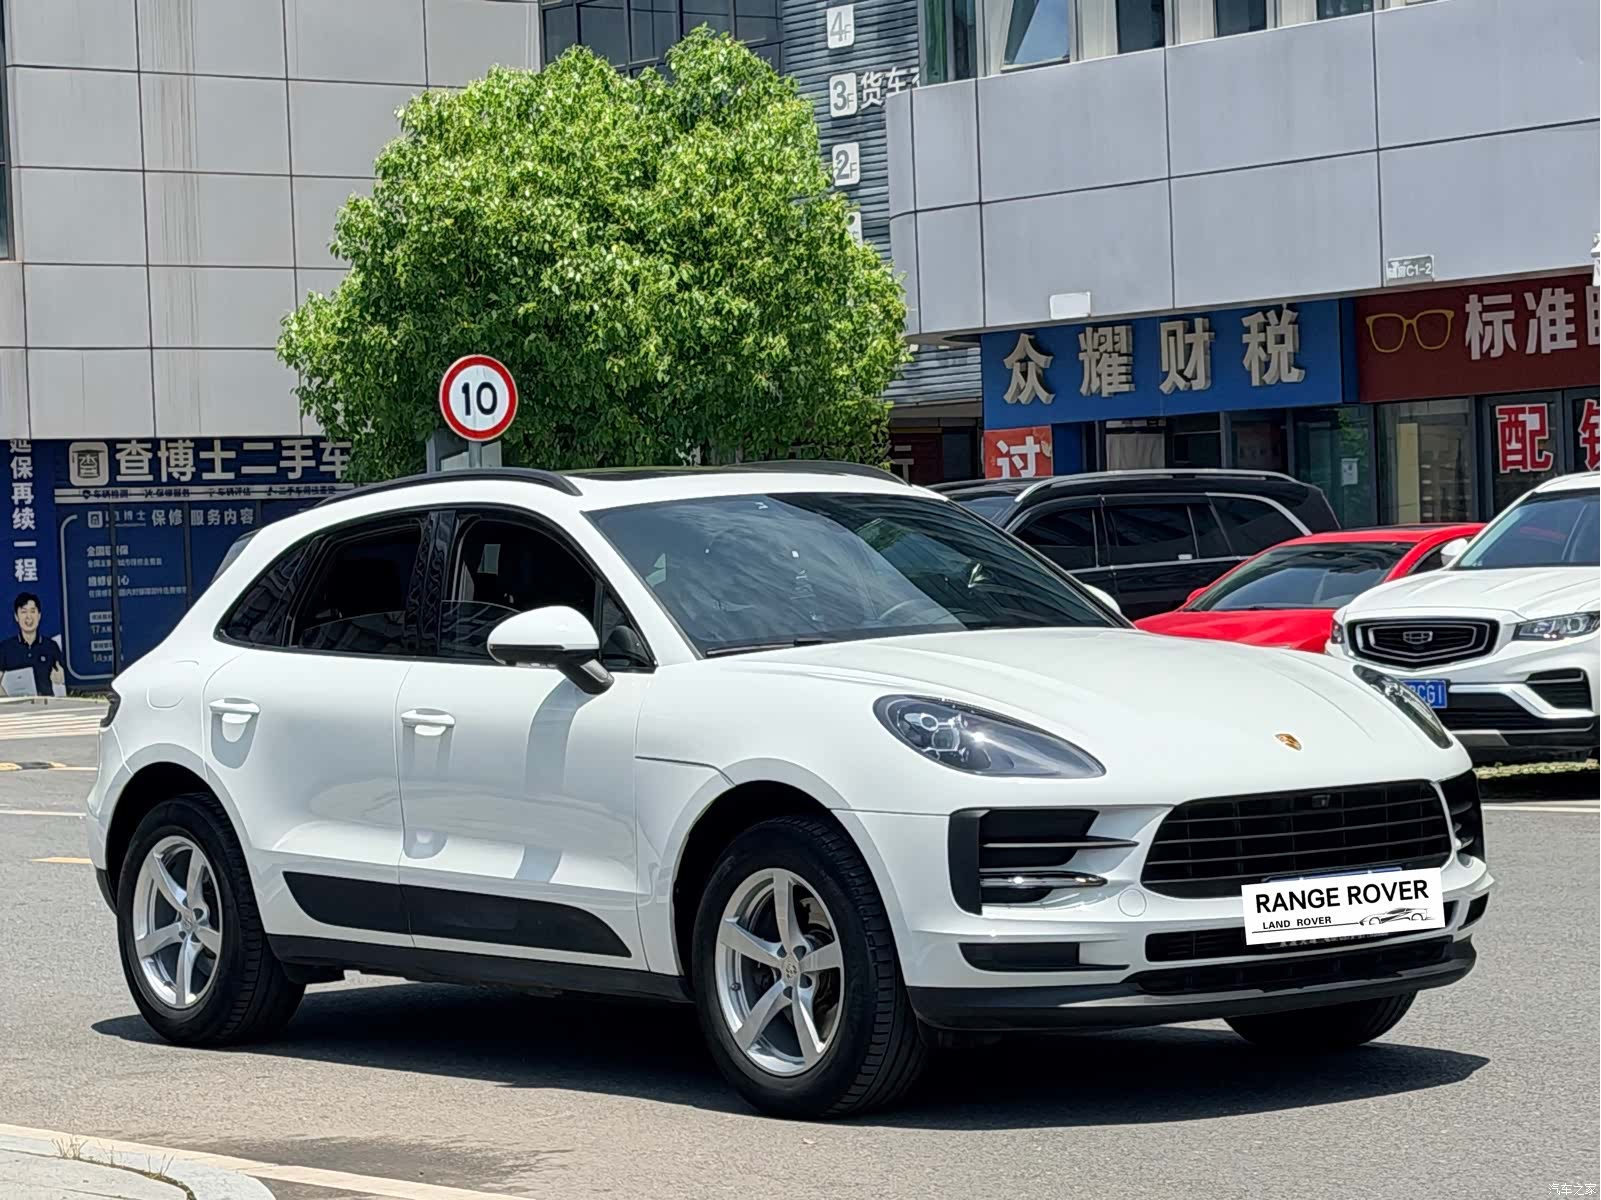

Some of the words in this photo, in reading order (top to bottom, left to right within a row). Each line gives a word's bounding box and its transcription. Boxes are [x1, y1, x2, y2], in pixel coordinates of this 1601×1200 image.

[829, 11, 852, 42] 4F
[832, 79, 855, 112] 3F
[860, 66, 920, 109] 货车
[835, 149, 858, 181] 2F
[1002, 302, 1306, 405] 众耀财税
[461, 381, 498, 416] 10
[115, 439, 352, 482] 查博士二手车
[1255, 887, 1341, 913] RANGE
[1347, 879, 1429, 905] ROVER
[1262, 919, 1291, 930] LAND
[1296, 916, 1332, 927] ROVER
